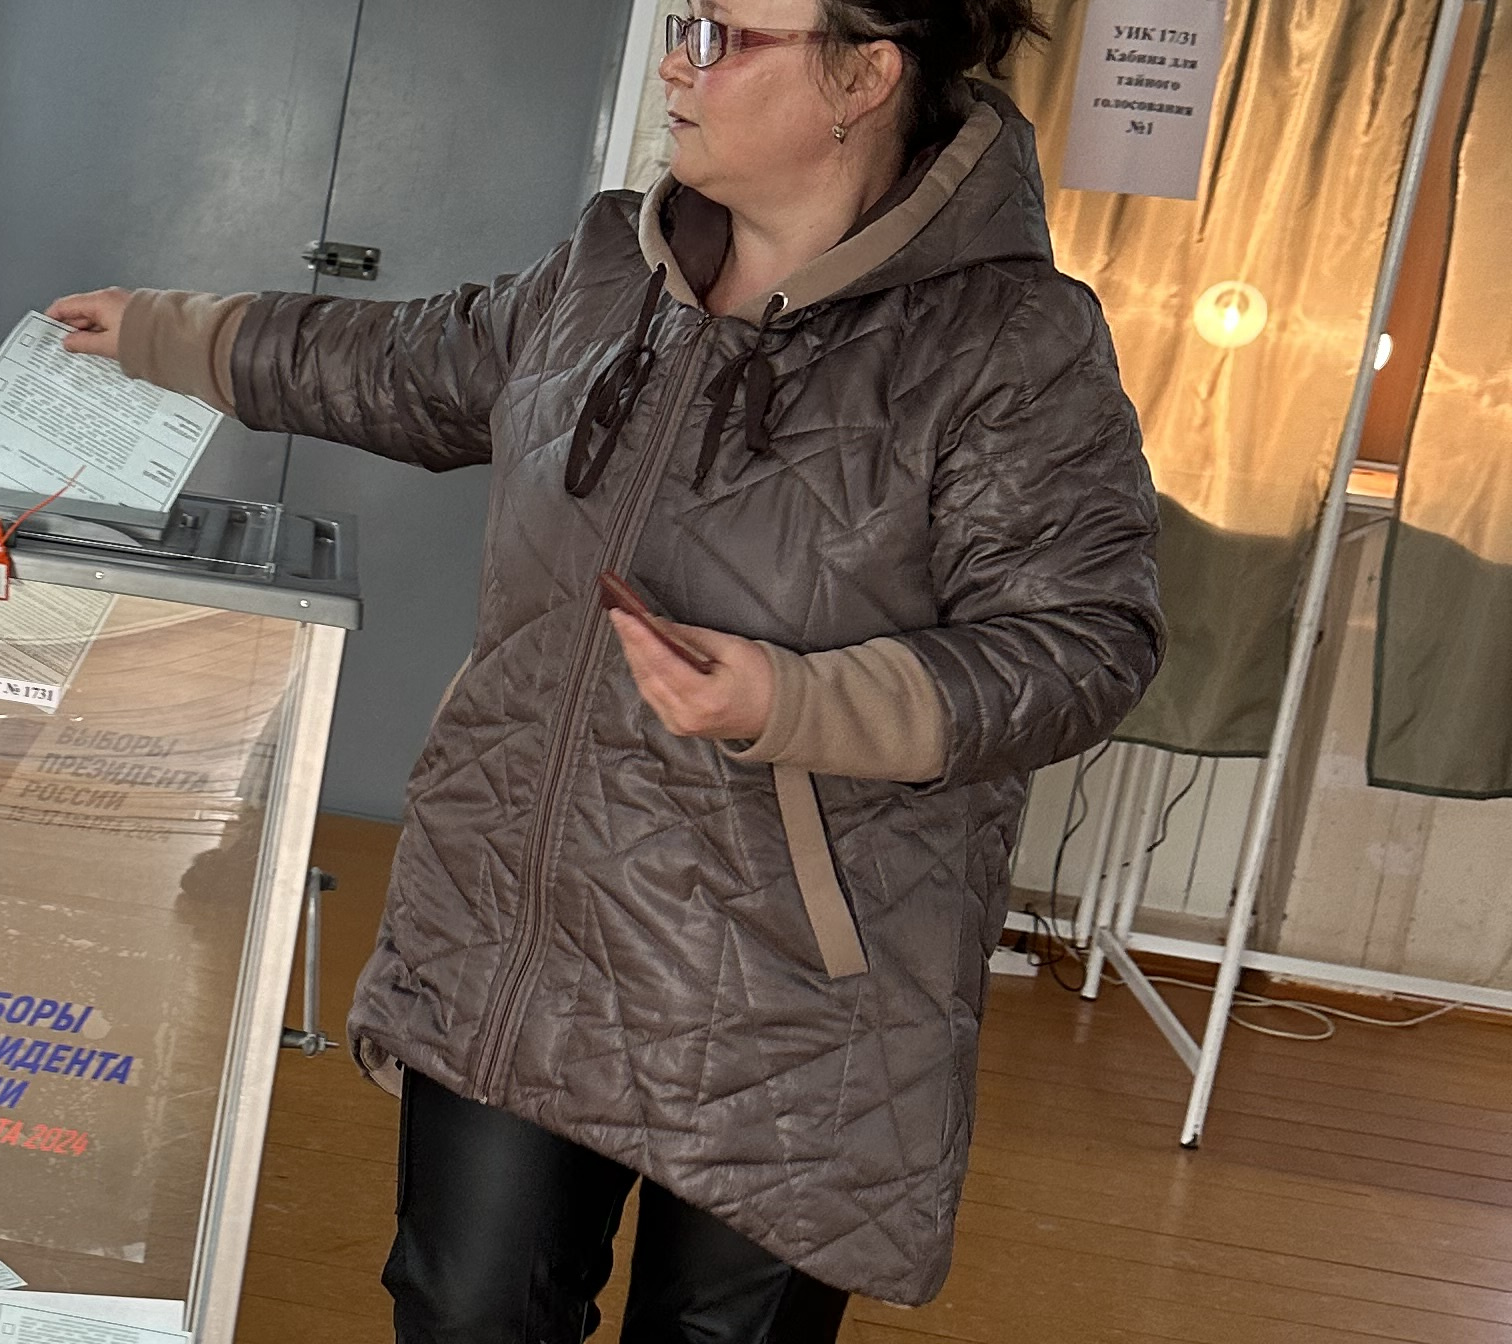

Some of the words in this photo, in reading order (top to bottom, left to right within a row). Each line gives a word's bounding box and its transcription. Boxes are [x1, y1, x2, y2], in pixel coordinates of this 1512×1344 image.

[1113, 25, 1157, 42] УИК
[1159, 28, 1198, 46] 17/31
[1105, 48, 1167, 66] Кабина
[1168, 58, 1199, 71] для
[1116, 74, 1181, 91] тайного
[1092, 97, 1194, 116] голосования
[1125, 119, 1154, 135] №1
[4, 682, 22, 696] №
[24, 685, 55, 702] 1731
[24, 1124, 90, 1156] 2024
